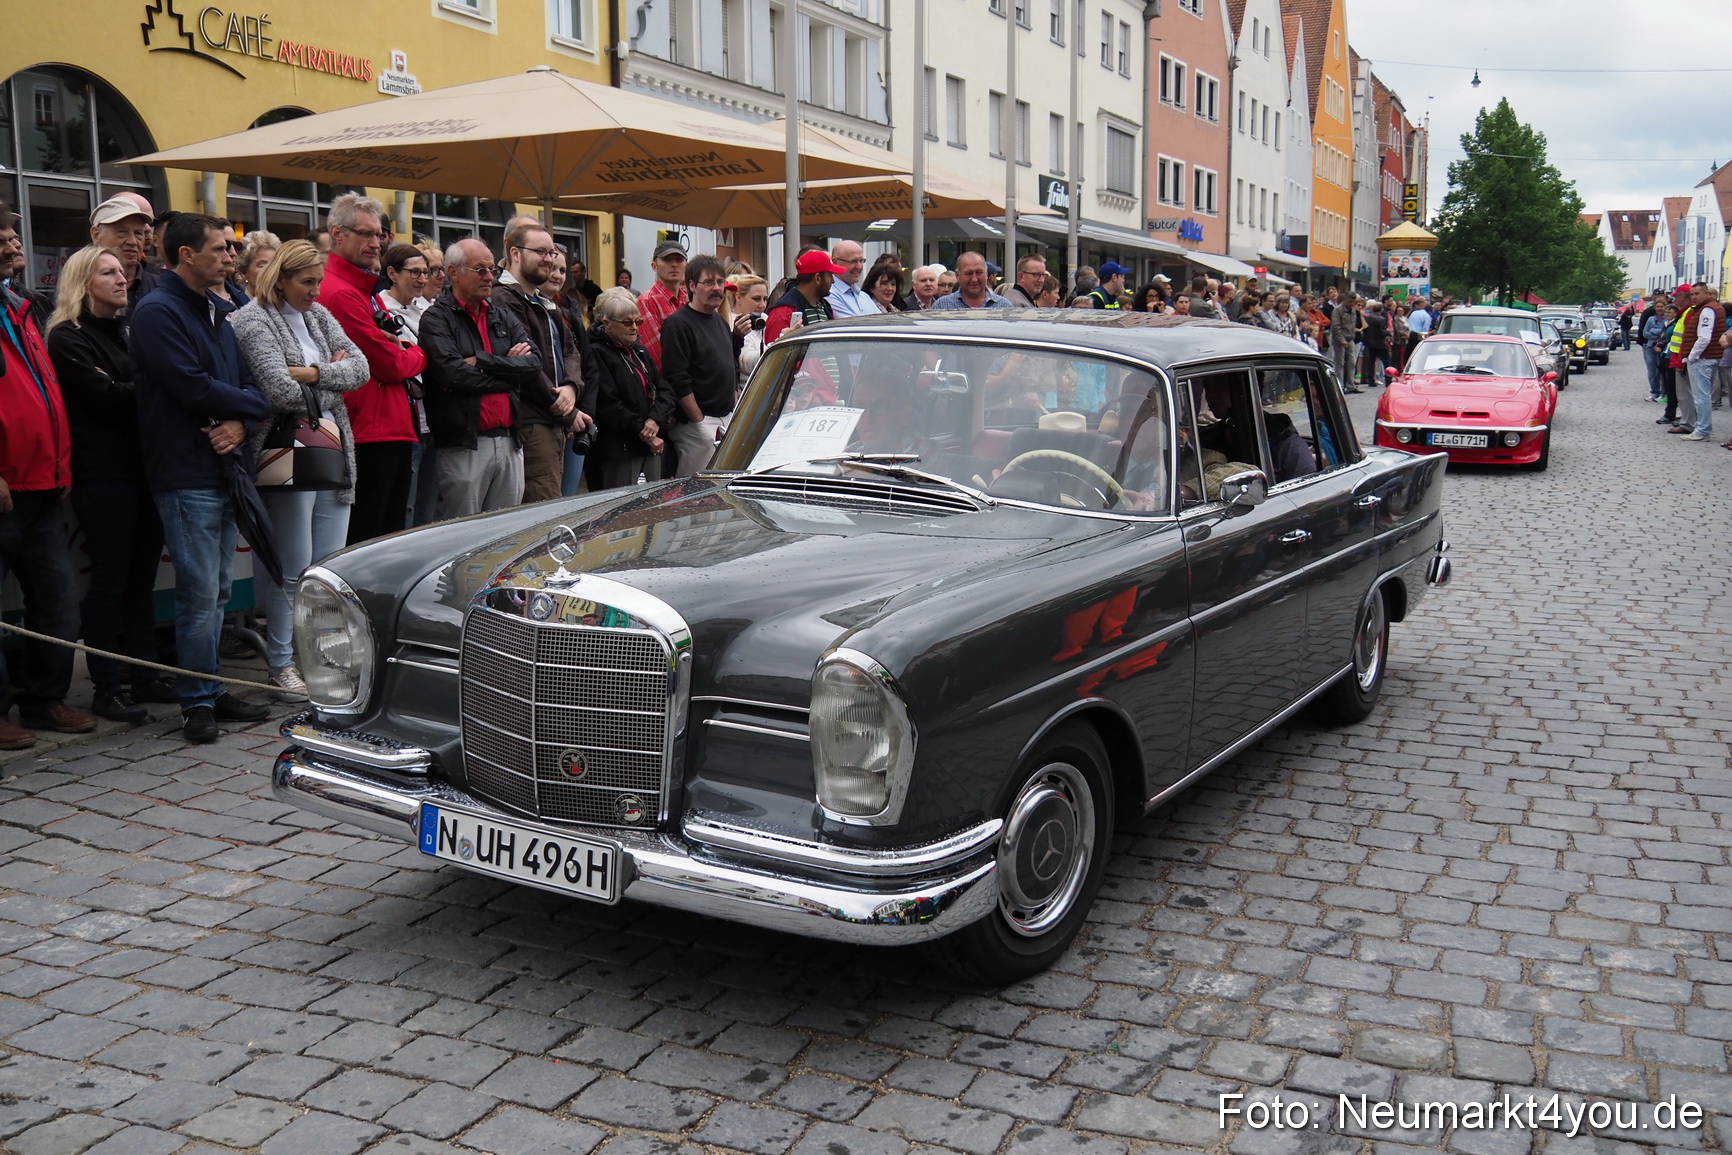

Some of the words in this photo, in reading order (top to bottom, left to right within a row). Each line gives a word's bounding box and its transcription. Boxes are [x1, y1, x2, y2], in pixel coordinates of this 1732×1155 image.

[199, 7, 273, 59] CAFÉ
[278, 39, 305, 66] AM
[307, 45, 373, 82] RATHAUS
[387, 73, 415, 85] Neumarkter
[381, 79, 420, 95] Lammsbräu
[602, 233, 611, 245] 24
[808, 419, 838, 433] 187
[425, 833, 433, 845] D
[438, 815, 458, 855] N
[476, 824, 515, 870] UH
[522, 837, 608, 891] 496H
